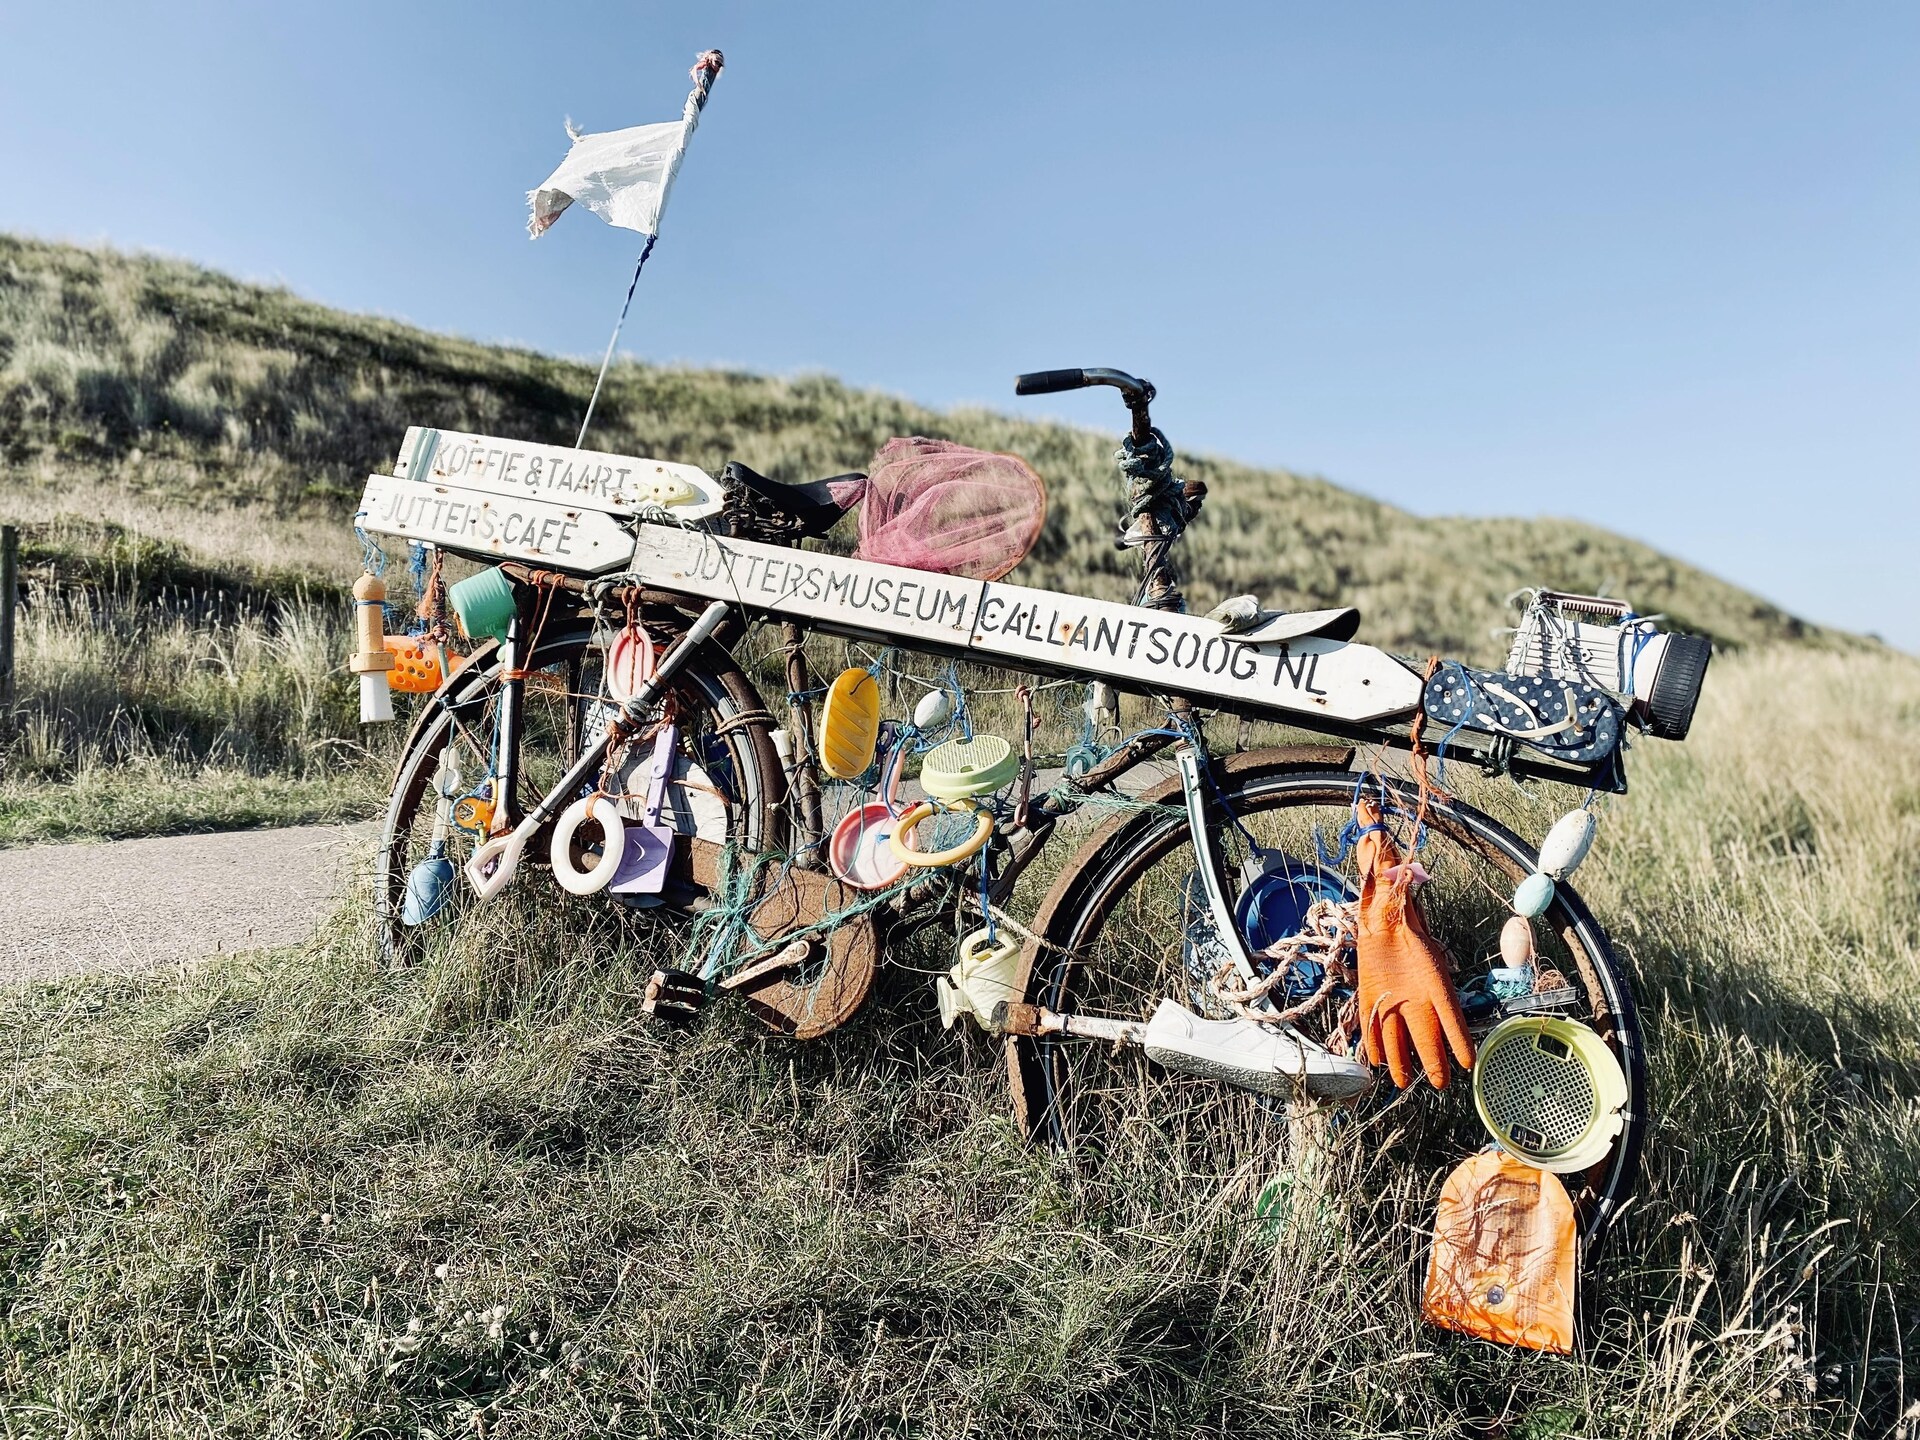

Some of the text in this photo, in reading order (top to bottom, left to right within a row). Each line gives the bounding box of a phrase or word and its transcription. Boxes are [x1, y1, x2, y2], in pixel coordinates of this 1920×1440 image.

[432, 441, 632, 498] KOFFIE & TAART
[381, 493, 498, 540] JUTTERS
[683, 547, 1328, 696] JUTTERSMUSEUM CALLANTSOOG NL
